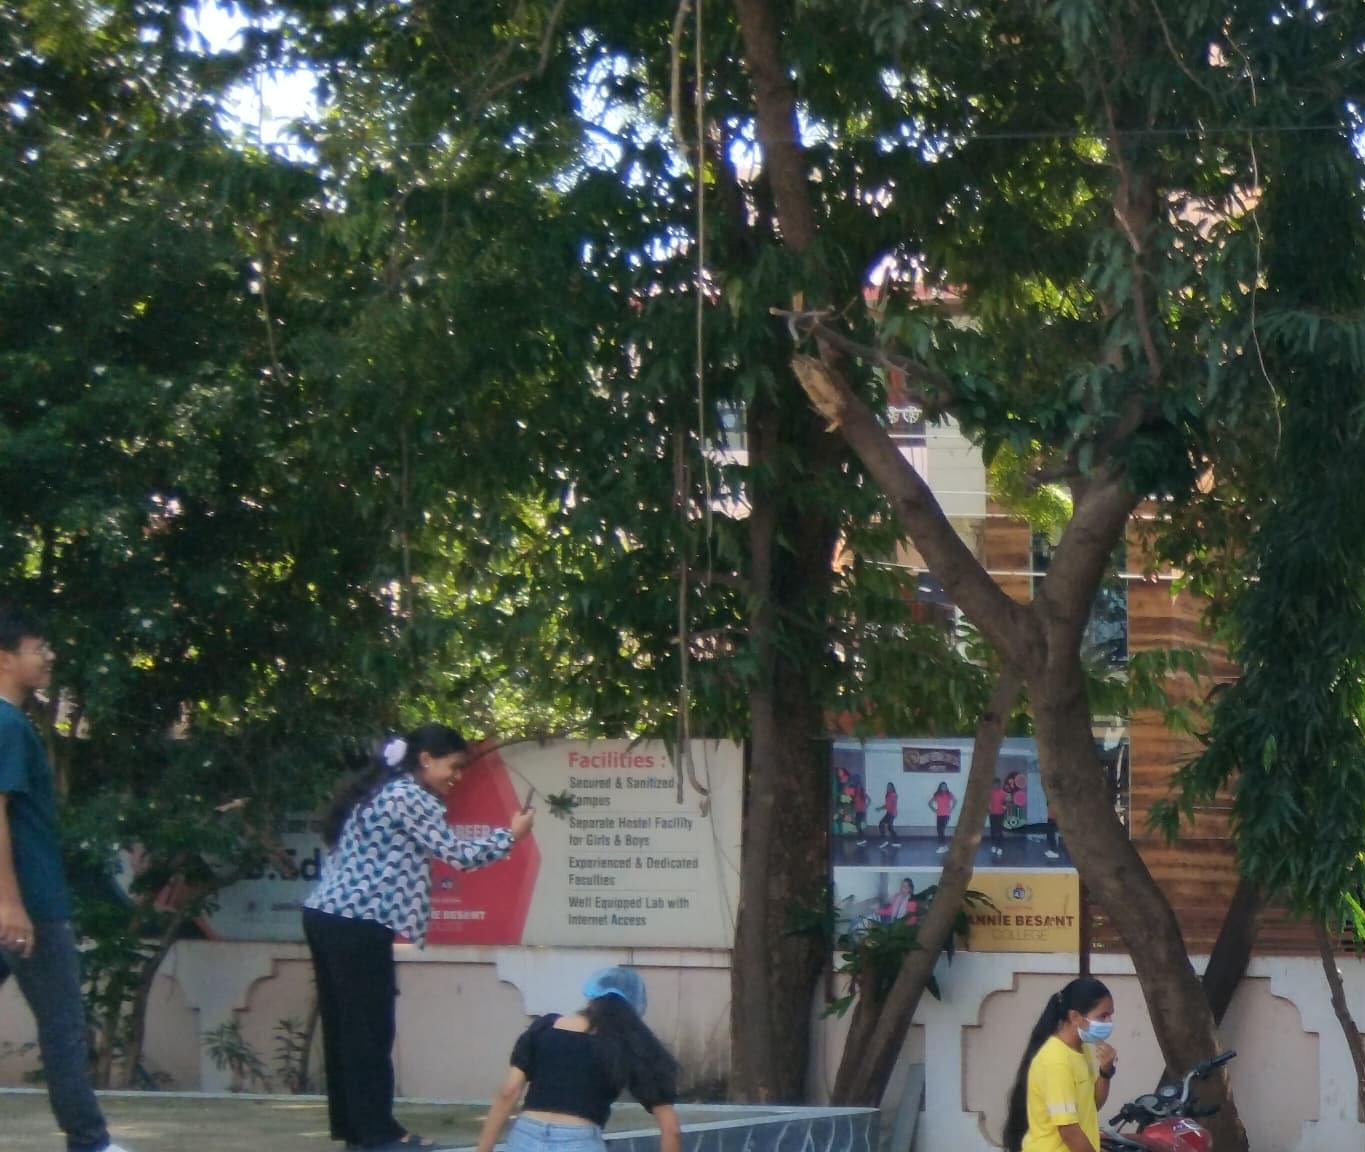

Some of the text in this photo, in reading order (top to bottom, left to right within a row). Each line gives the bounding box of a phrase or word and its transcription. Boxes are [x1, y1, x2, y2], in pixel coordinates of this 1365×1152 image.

[568, 752, 654, 768] Facilities
[569, 777, 674, 789] Secured & Sanitized
[569, 817, 693, 831] Separate Hostel Facility
[569, 834, 650, 848] for Girls & Boys
[568, 857, 698, 870] Experienced & Dedicated
[568, 874, 615, 886] Faculties
[568, 897, 689, 910] Well Equipped Lab with
[568, 914, 647, 926] Internet Access
[1015, 915, 1074, 927] BESANT
